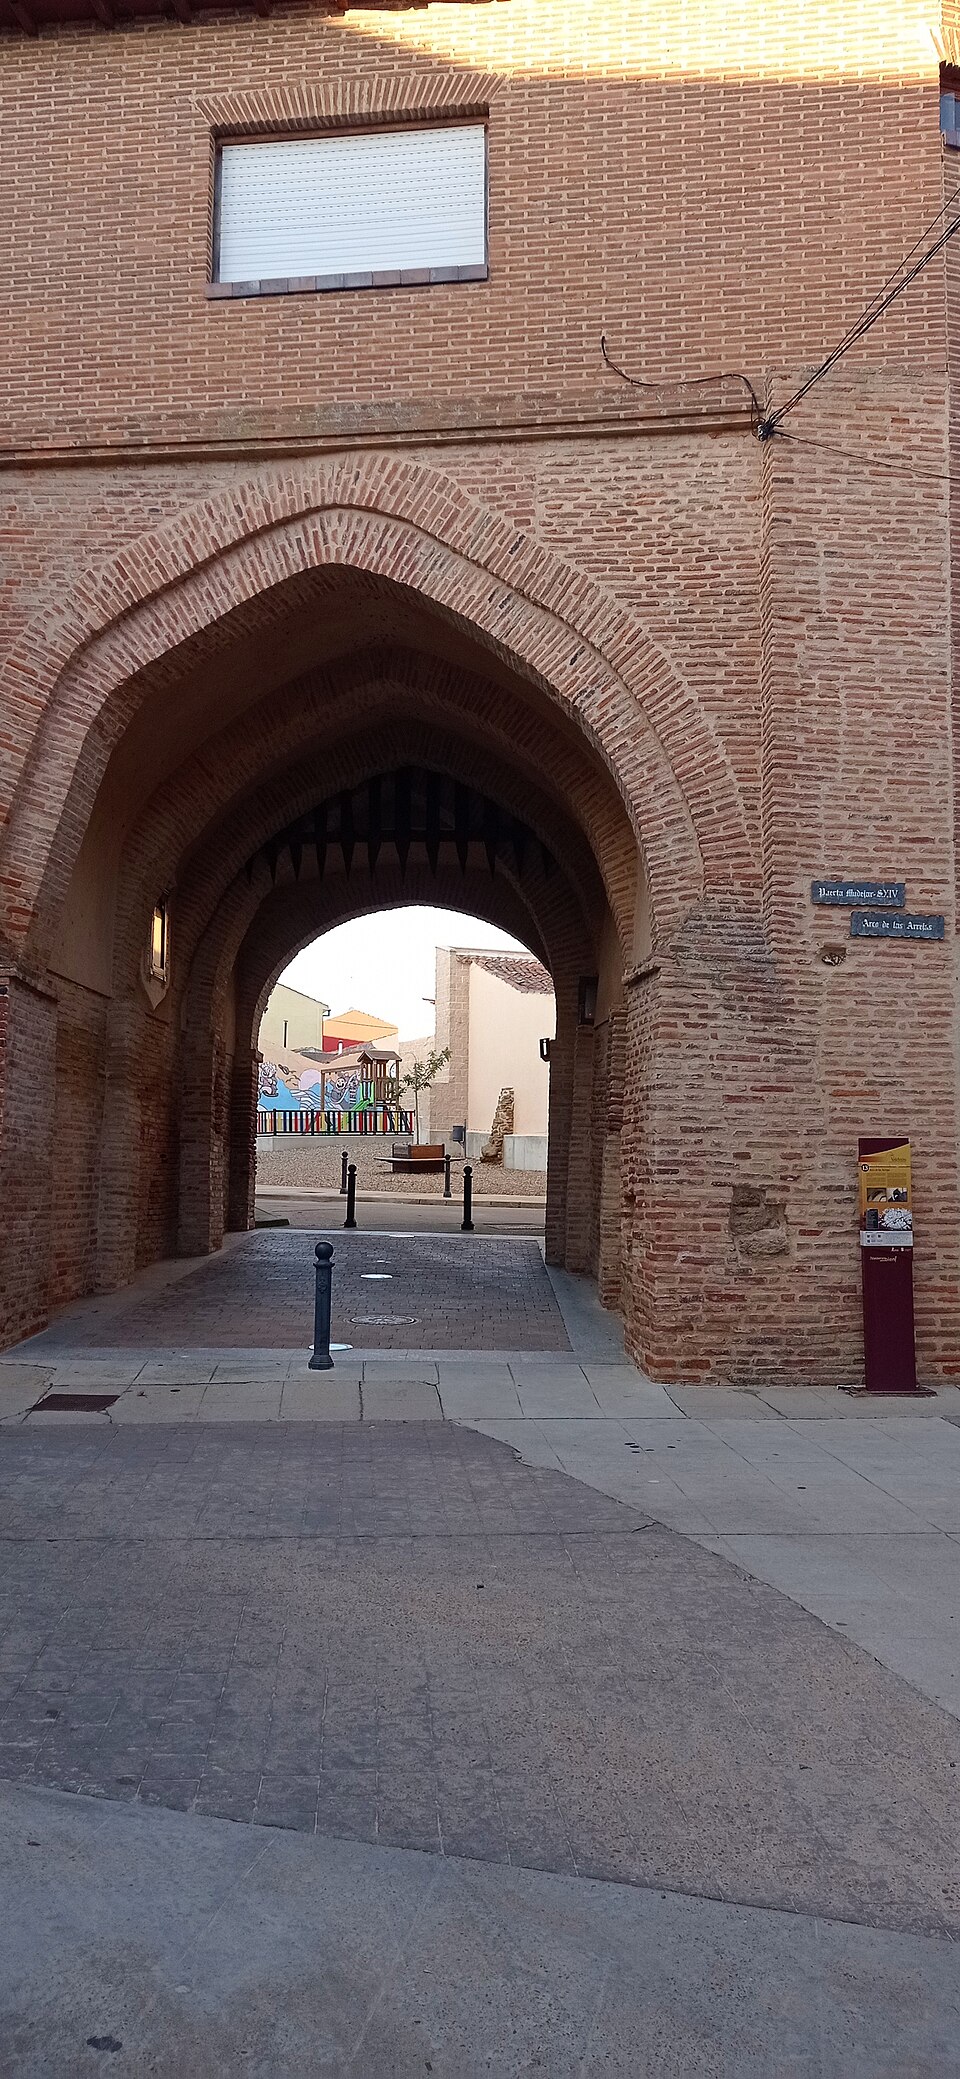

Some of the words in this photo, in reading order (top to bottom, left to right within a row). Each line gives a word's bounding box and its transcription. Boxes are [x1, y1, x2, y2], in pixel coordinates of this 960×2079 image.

[862, 918, 879, 928] Arco
[882, 920, 890, 929] de
[893, 921, 904, 930] las
